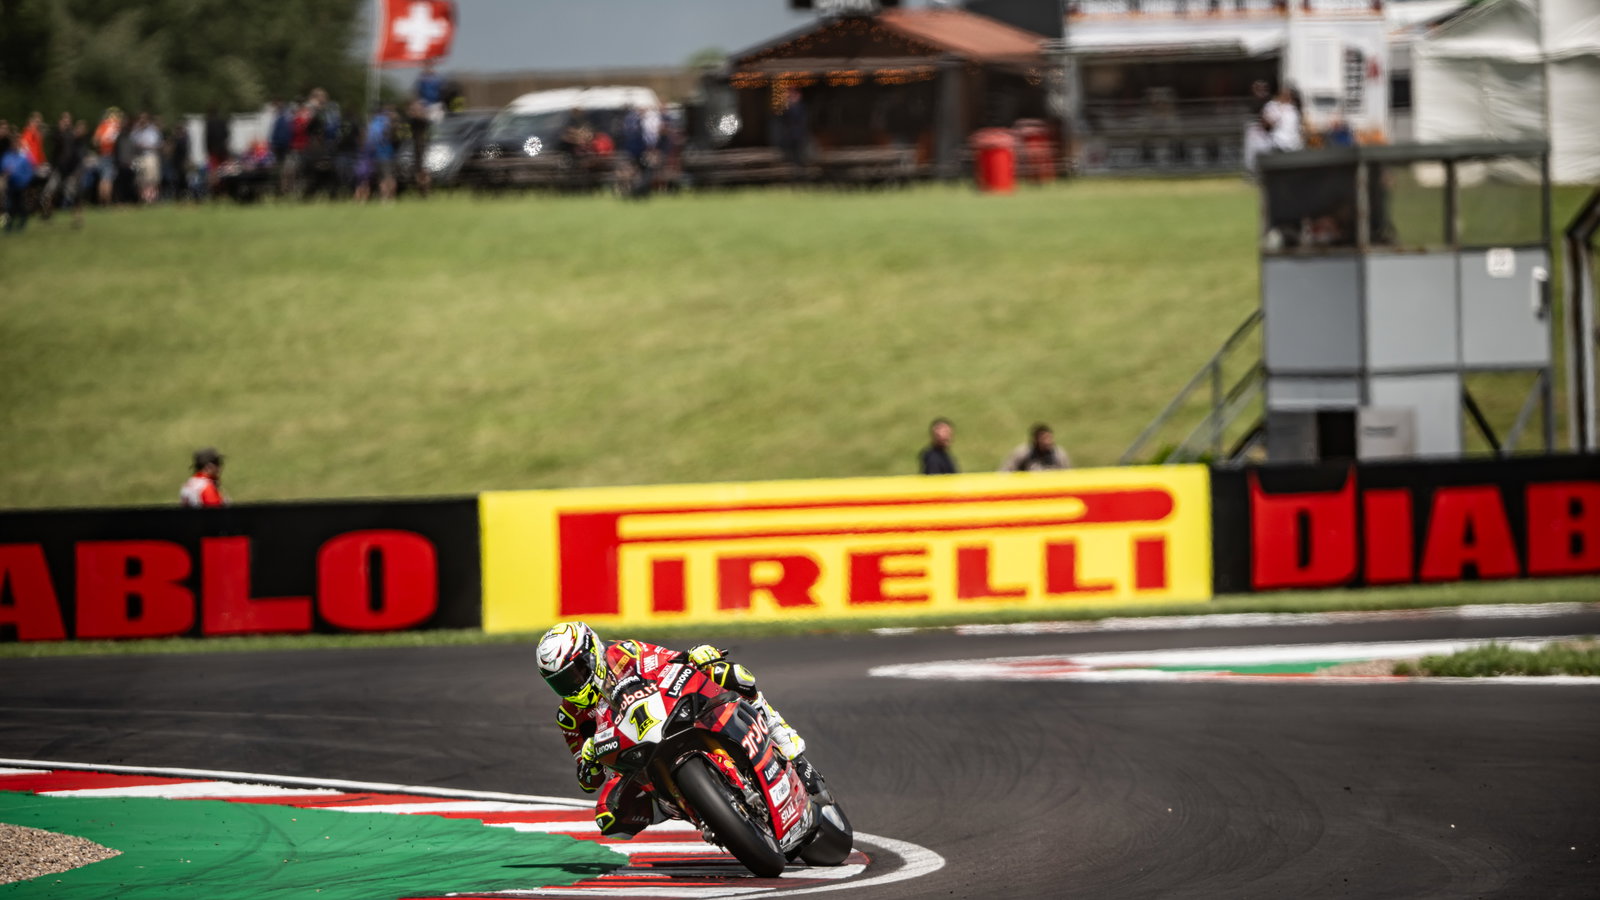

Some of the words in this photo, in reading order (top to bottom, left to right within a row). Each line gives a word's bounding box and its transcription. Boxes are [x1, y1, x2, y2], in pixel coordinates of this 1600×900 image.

[1249, 465, 1600, 590] DIAB
[558, 488, 1175, 615] PIRELLI
[668, 668, 693, 697] Lenovo
[630, 701, 662, 741] 1
[595, 740, 619, 755] Lenovo
